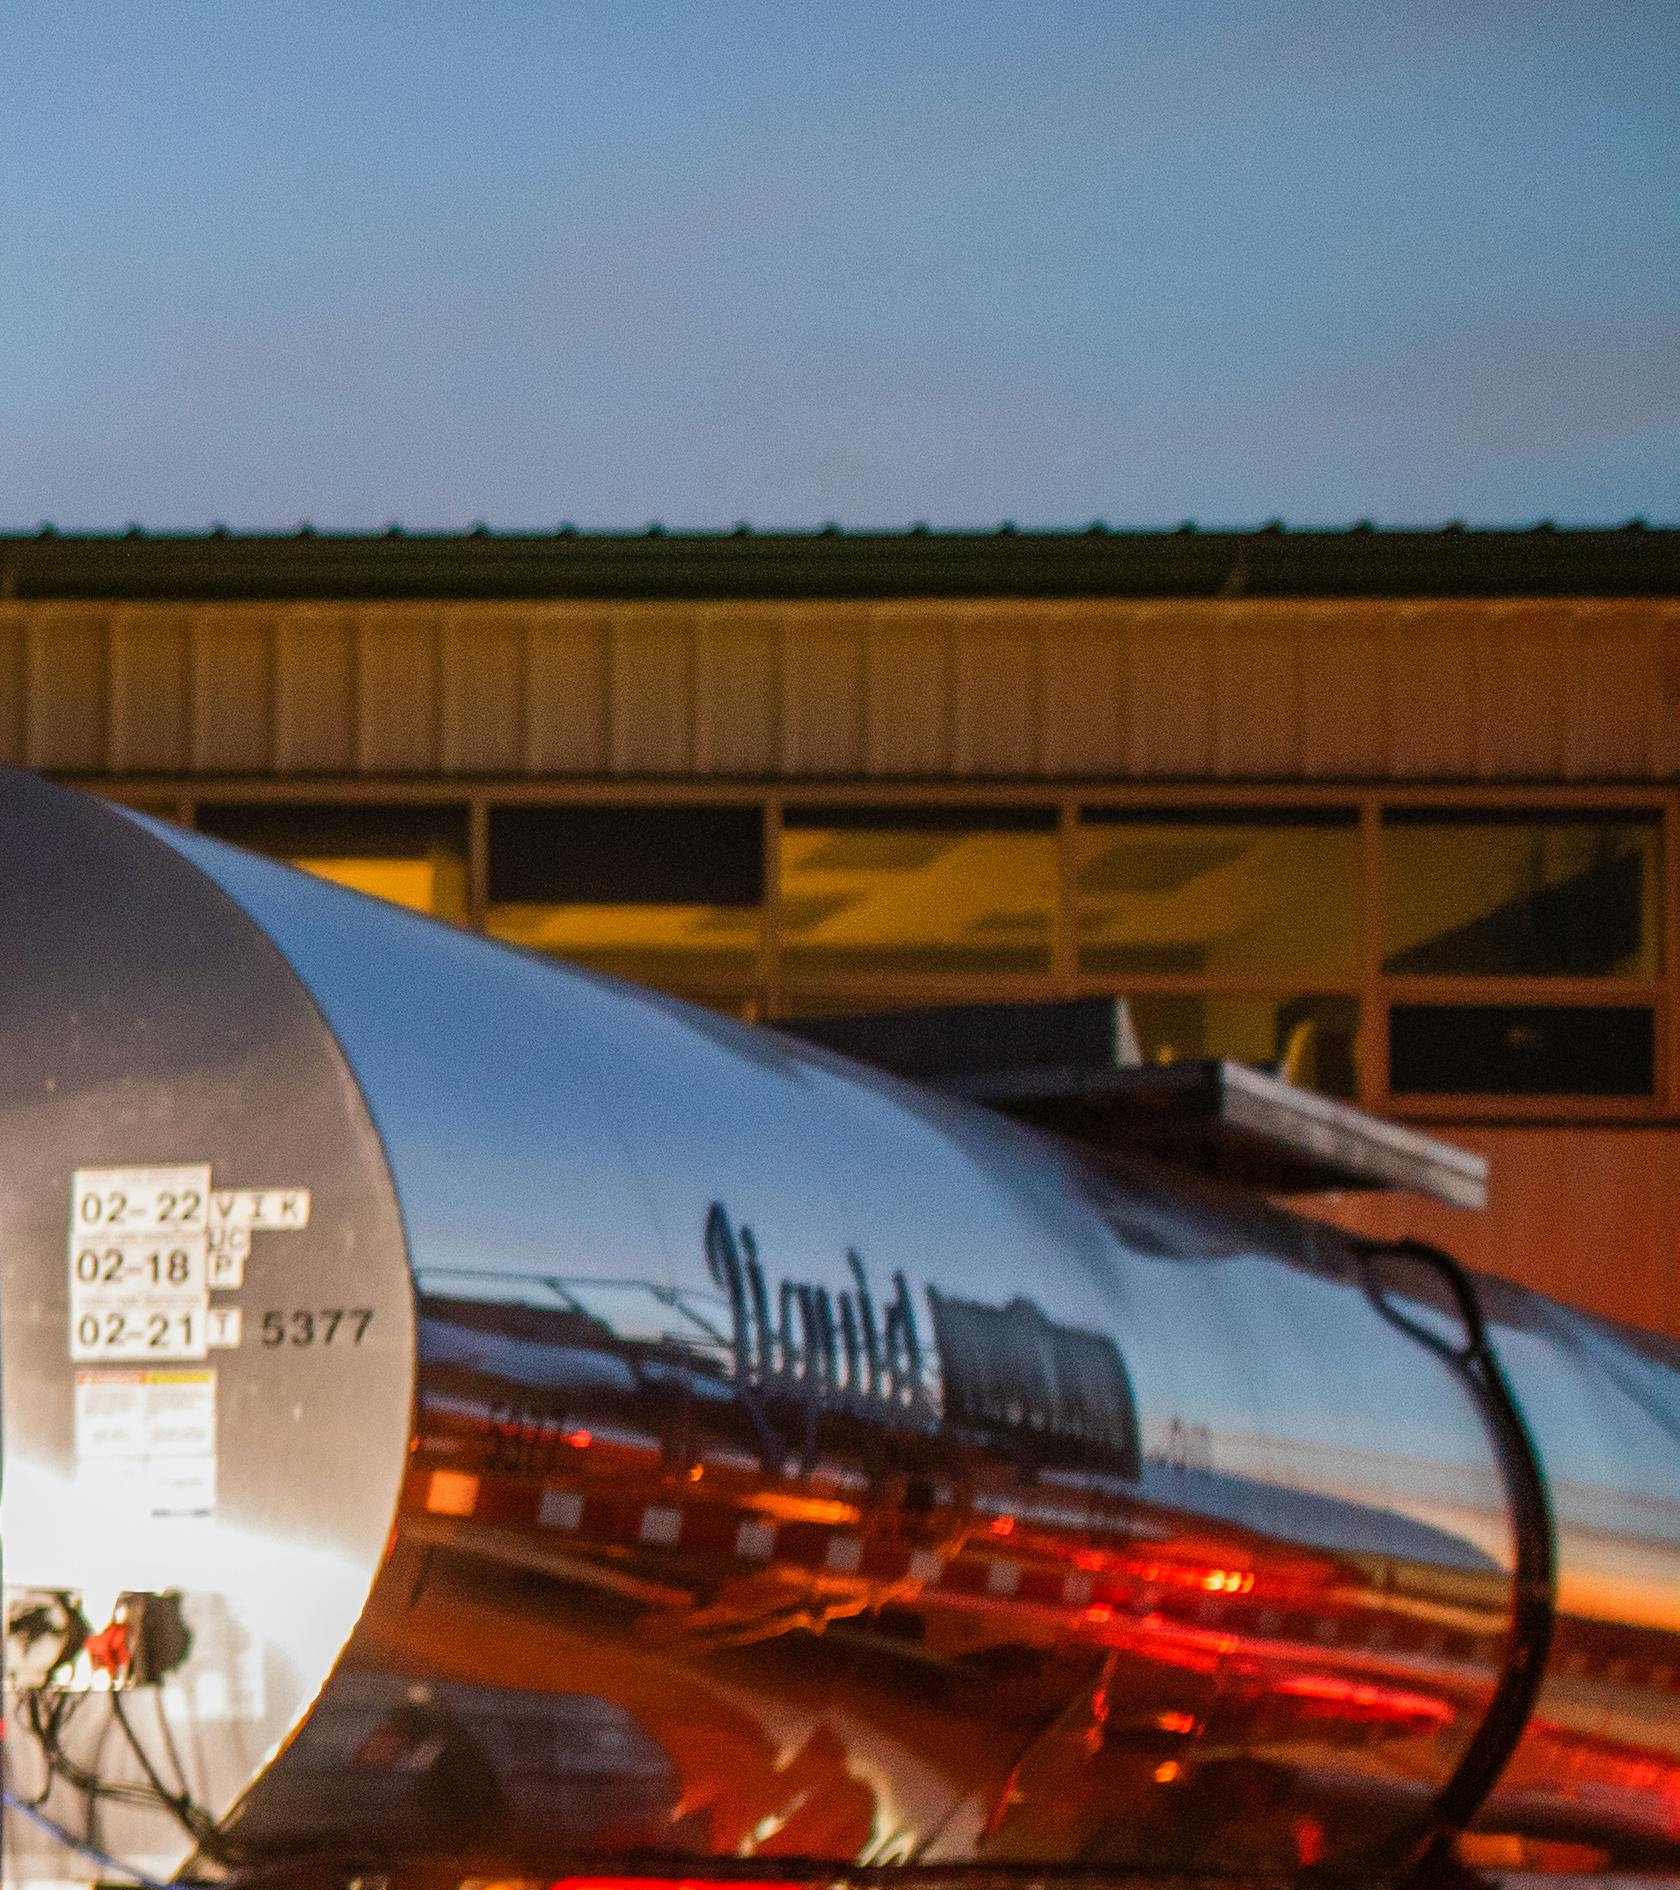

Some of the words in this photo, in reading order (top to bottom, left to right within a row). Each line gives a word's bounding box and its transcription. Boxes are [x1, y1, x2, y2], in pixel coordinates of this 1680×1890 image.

[80, 1190, 203, 1224] 02-22
[75, 1249, 190, 1286] 02-18
[78, 1311, 194, 1347] 02-21
[261, 1308, 375, 1348] 5377
